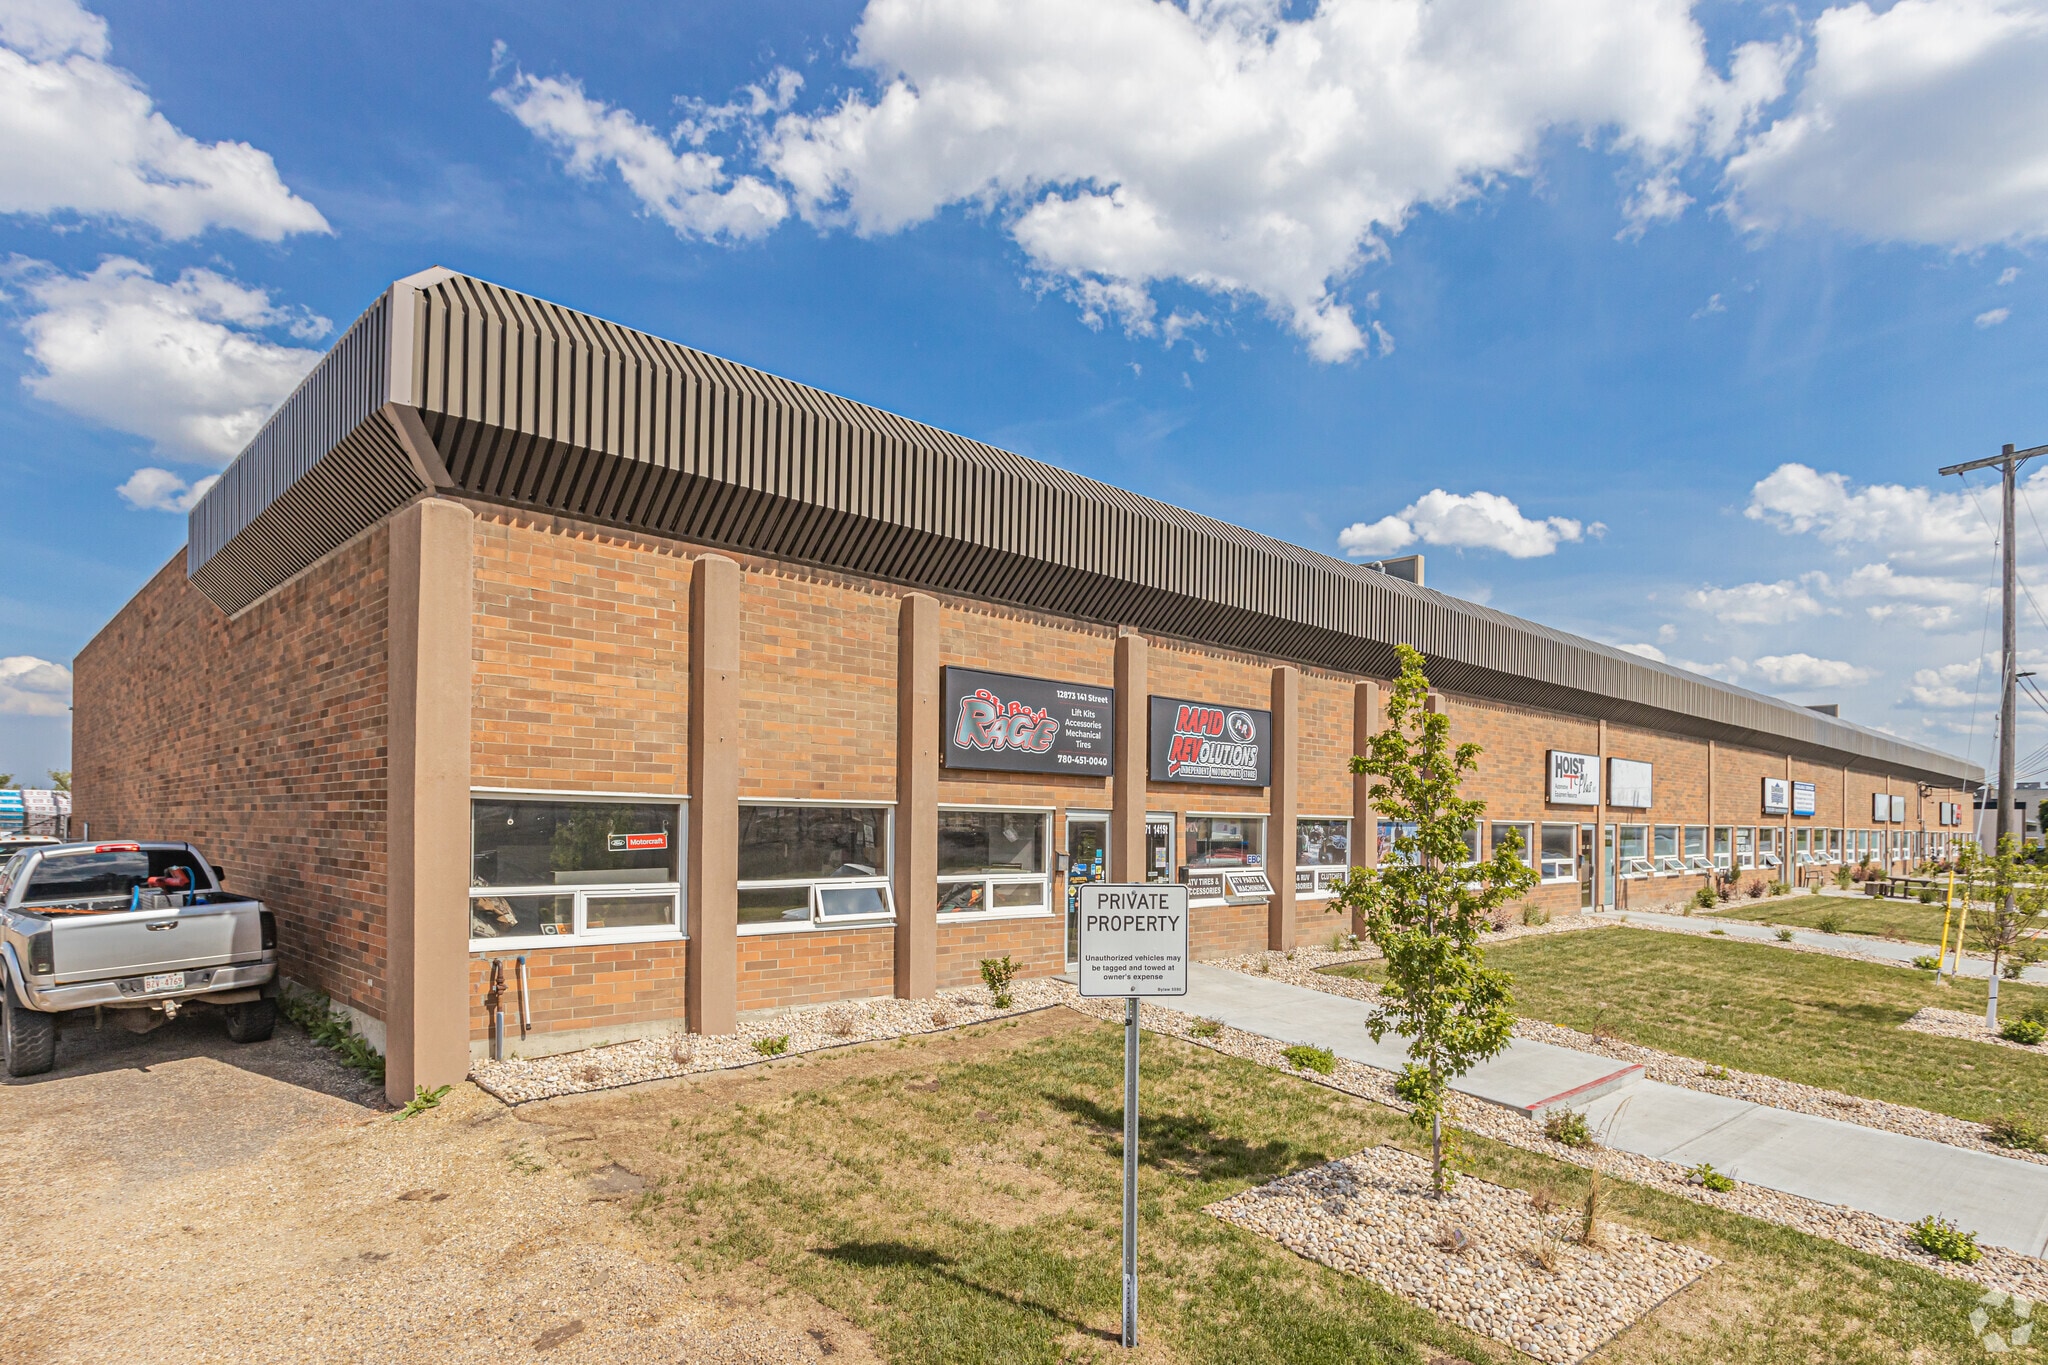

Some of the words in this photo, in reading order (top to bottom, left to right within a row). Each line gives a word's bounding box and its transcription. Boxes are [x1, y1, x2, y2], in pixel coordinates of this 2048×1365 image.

[1057, 690, 1076, 700] 12873
[1077, 692, 1087, 701] 141
[1088, 693, 1108, 704] Street
[1008, 701, 1048, 724] Road
[1071, 708, 1083, 717] Lift
[1083, 710, 1096, 718] Kits
[955, 696, 1060, 752] RAGE
[1065, 719, 1102, 729] Accessories
[1175, 706, 1224, 736] RAPID
[1065, 729, 1101, 739] Mechanical
[1075, 740, 1092, 749] Tires
[1168, 735, 1258, 767] REVOLUTIONS
[1057, 754, 1108, 766] 780-451-0040
[1180, 765, 1210, 776] INDEPENDENT
[1211, 767, 1241, 778] MOTORSPORTS
[1242, 768, 1257, 778] STORE
[1555, 755, 1585, 779] HOIST
[1186, 821, 1198, 832] PEN
[1247, 855, 1261, 864] EBC
[1188, 878, 1198, 886] ATV
[1215, 877, 1219, 885] &
[1231, 876, 1241, 884] ATV
[1188, 887, 1221, 895] CCESSORIES
[1098, 893, 1169, 909] PRIVATE
[1087, 916, 1180, 931] PROPERTY
